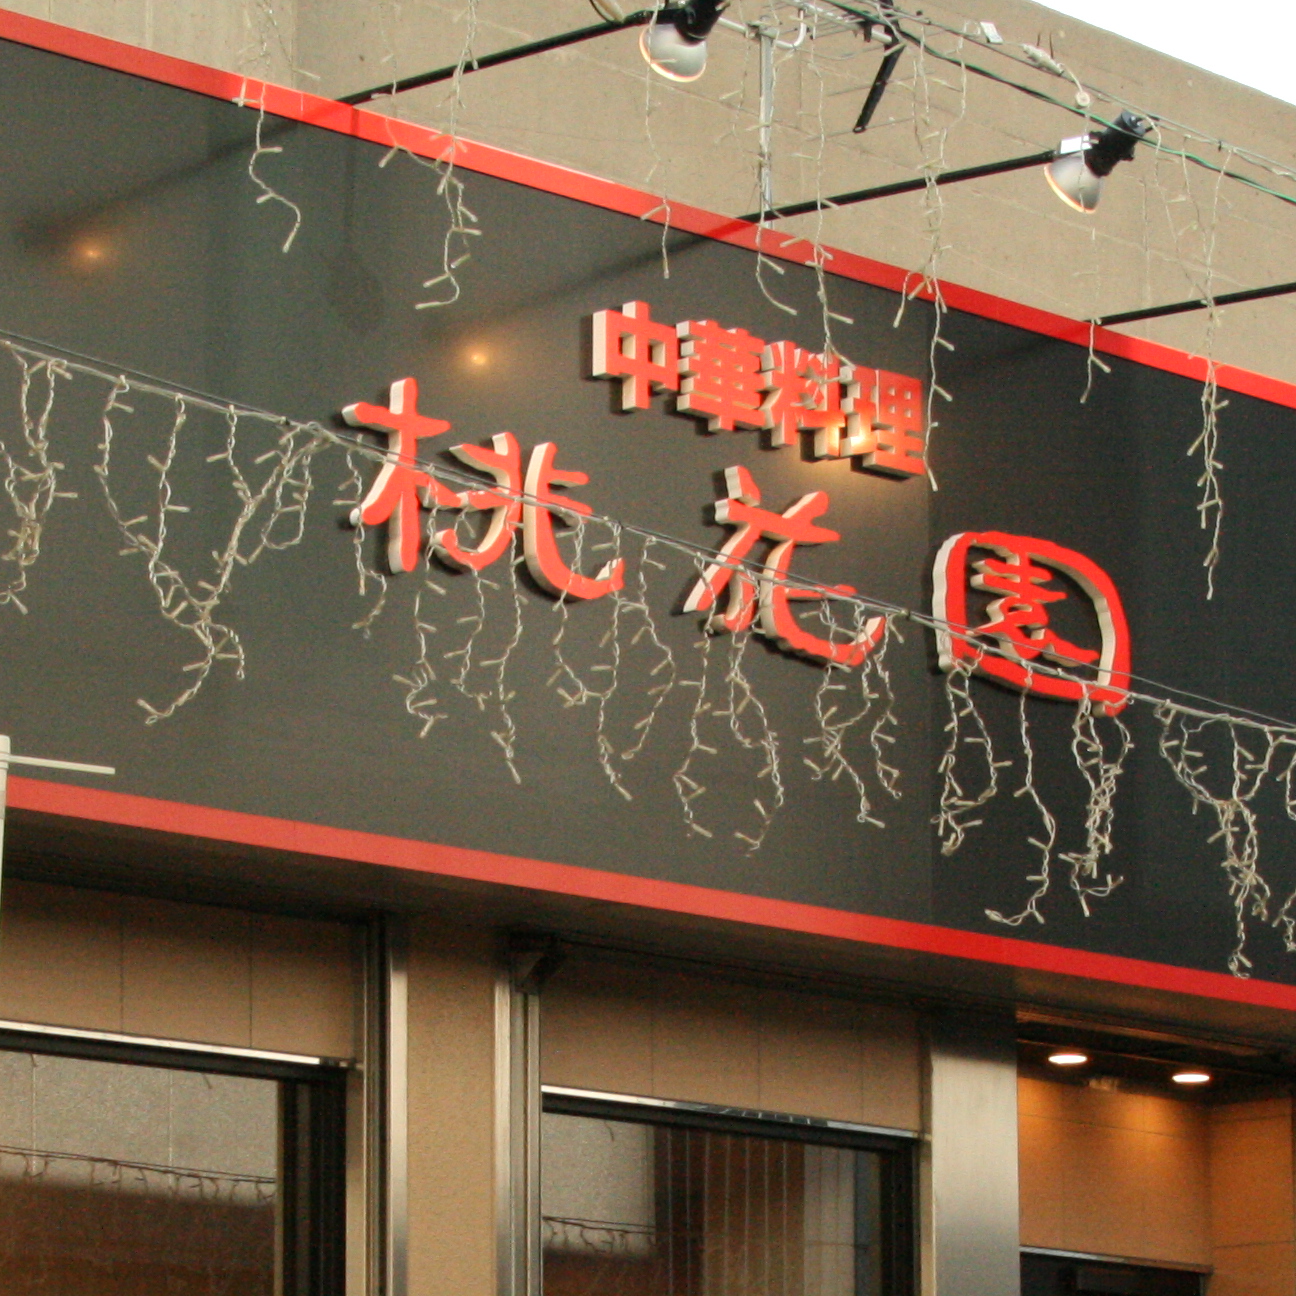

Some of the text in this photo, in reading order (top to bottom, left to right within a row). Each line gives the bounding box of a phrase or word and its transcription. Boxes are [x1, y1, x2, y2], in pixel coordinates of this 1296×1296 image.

[592, 300, 925, 479] 中華料理
[341, 377, 1132, 717] 桃花園
